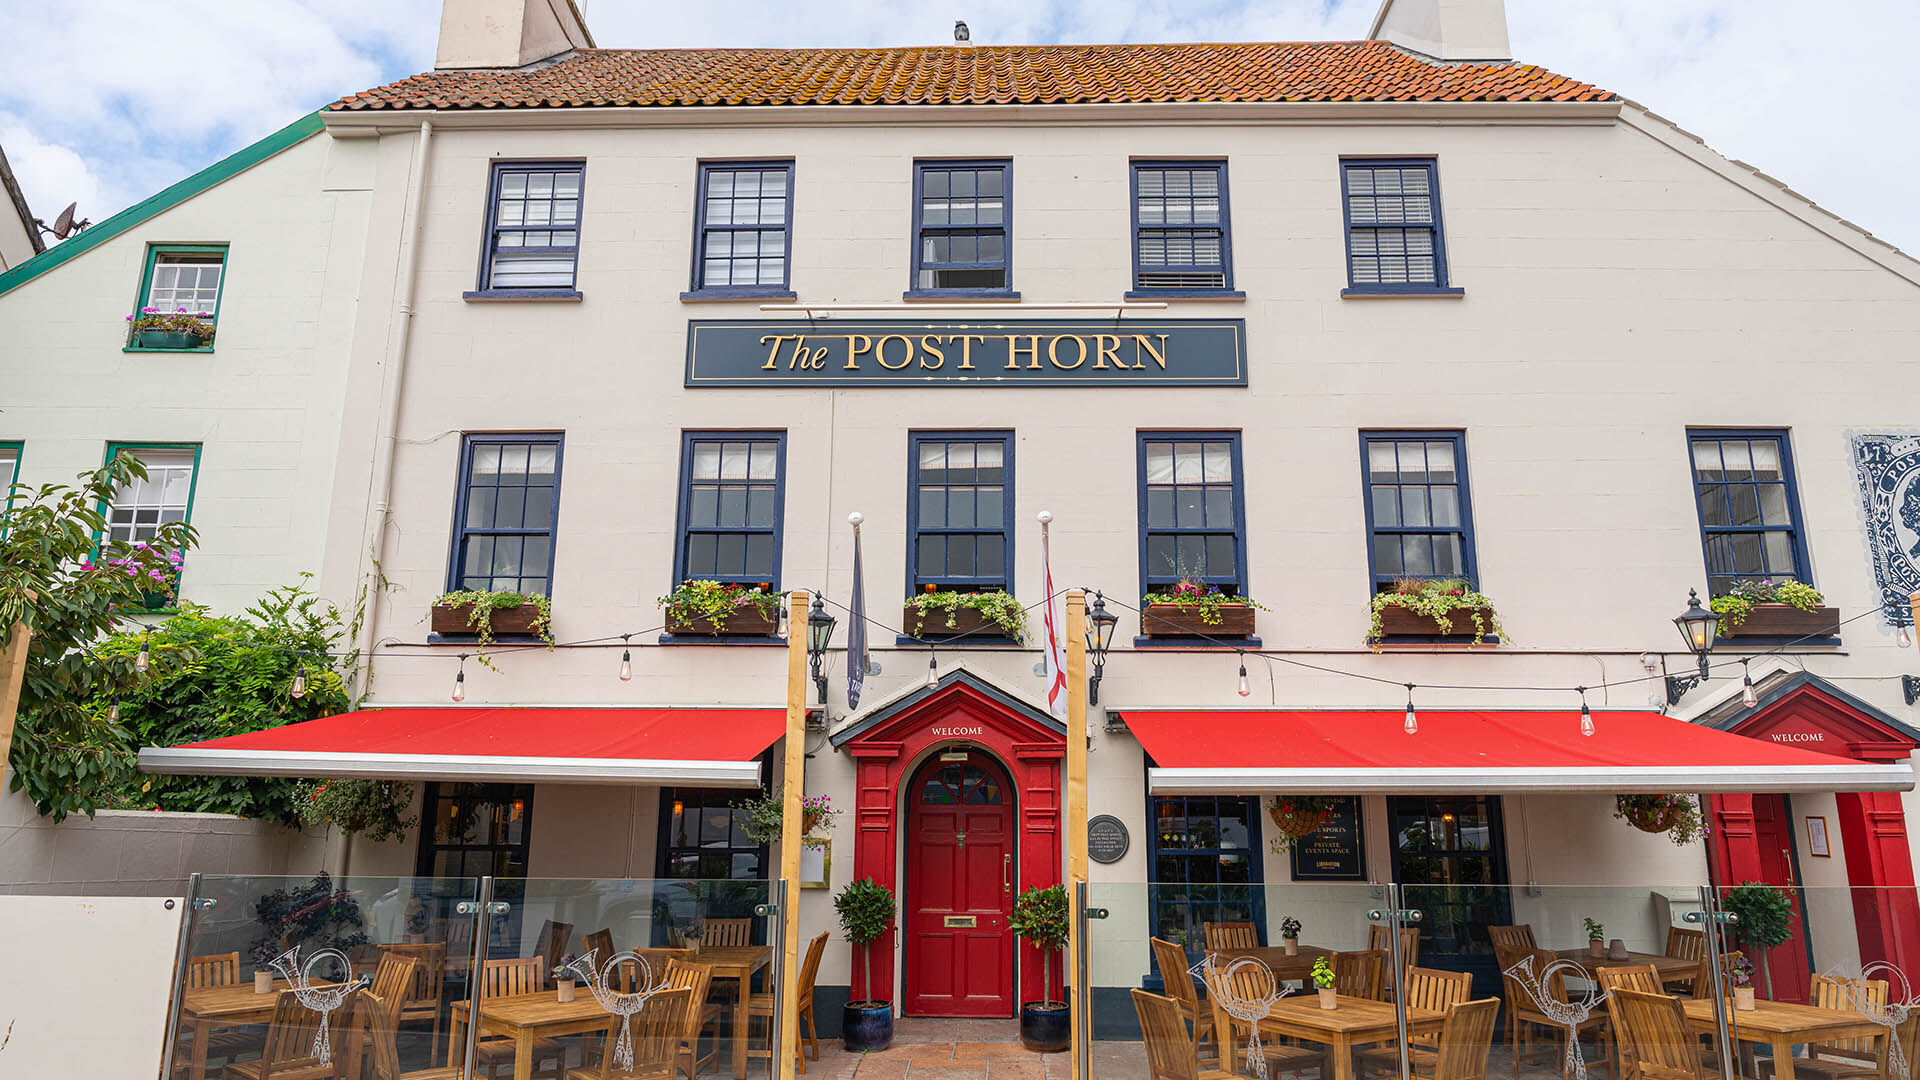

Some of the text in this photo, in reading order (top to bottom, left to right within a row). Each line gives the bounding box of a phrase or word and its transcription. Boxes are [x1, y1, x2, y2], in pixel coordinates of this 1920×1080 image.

[760, 333, 1171, 370] The POST HORN
[932, 727, 982, 735] WELCOME
[1771, 733, 1824, 742] WELCOME
